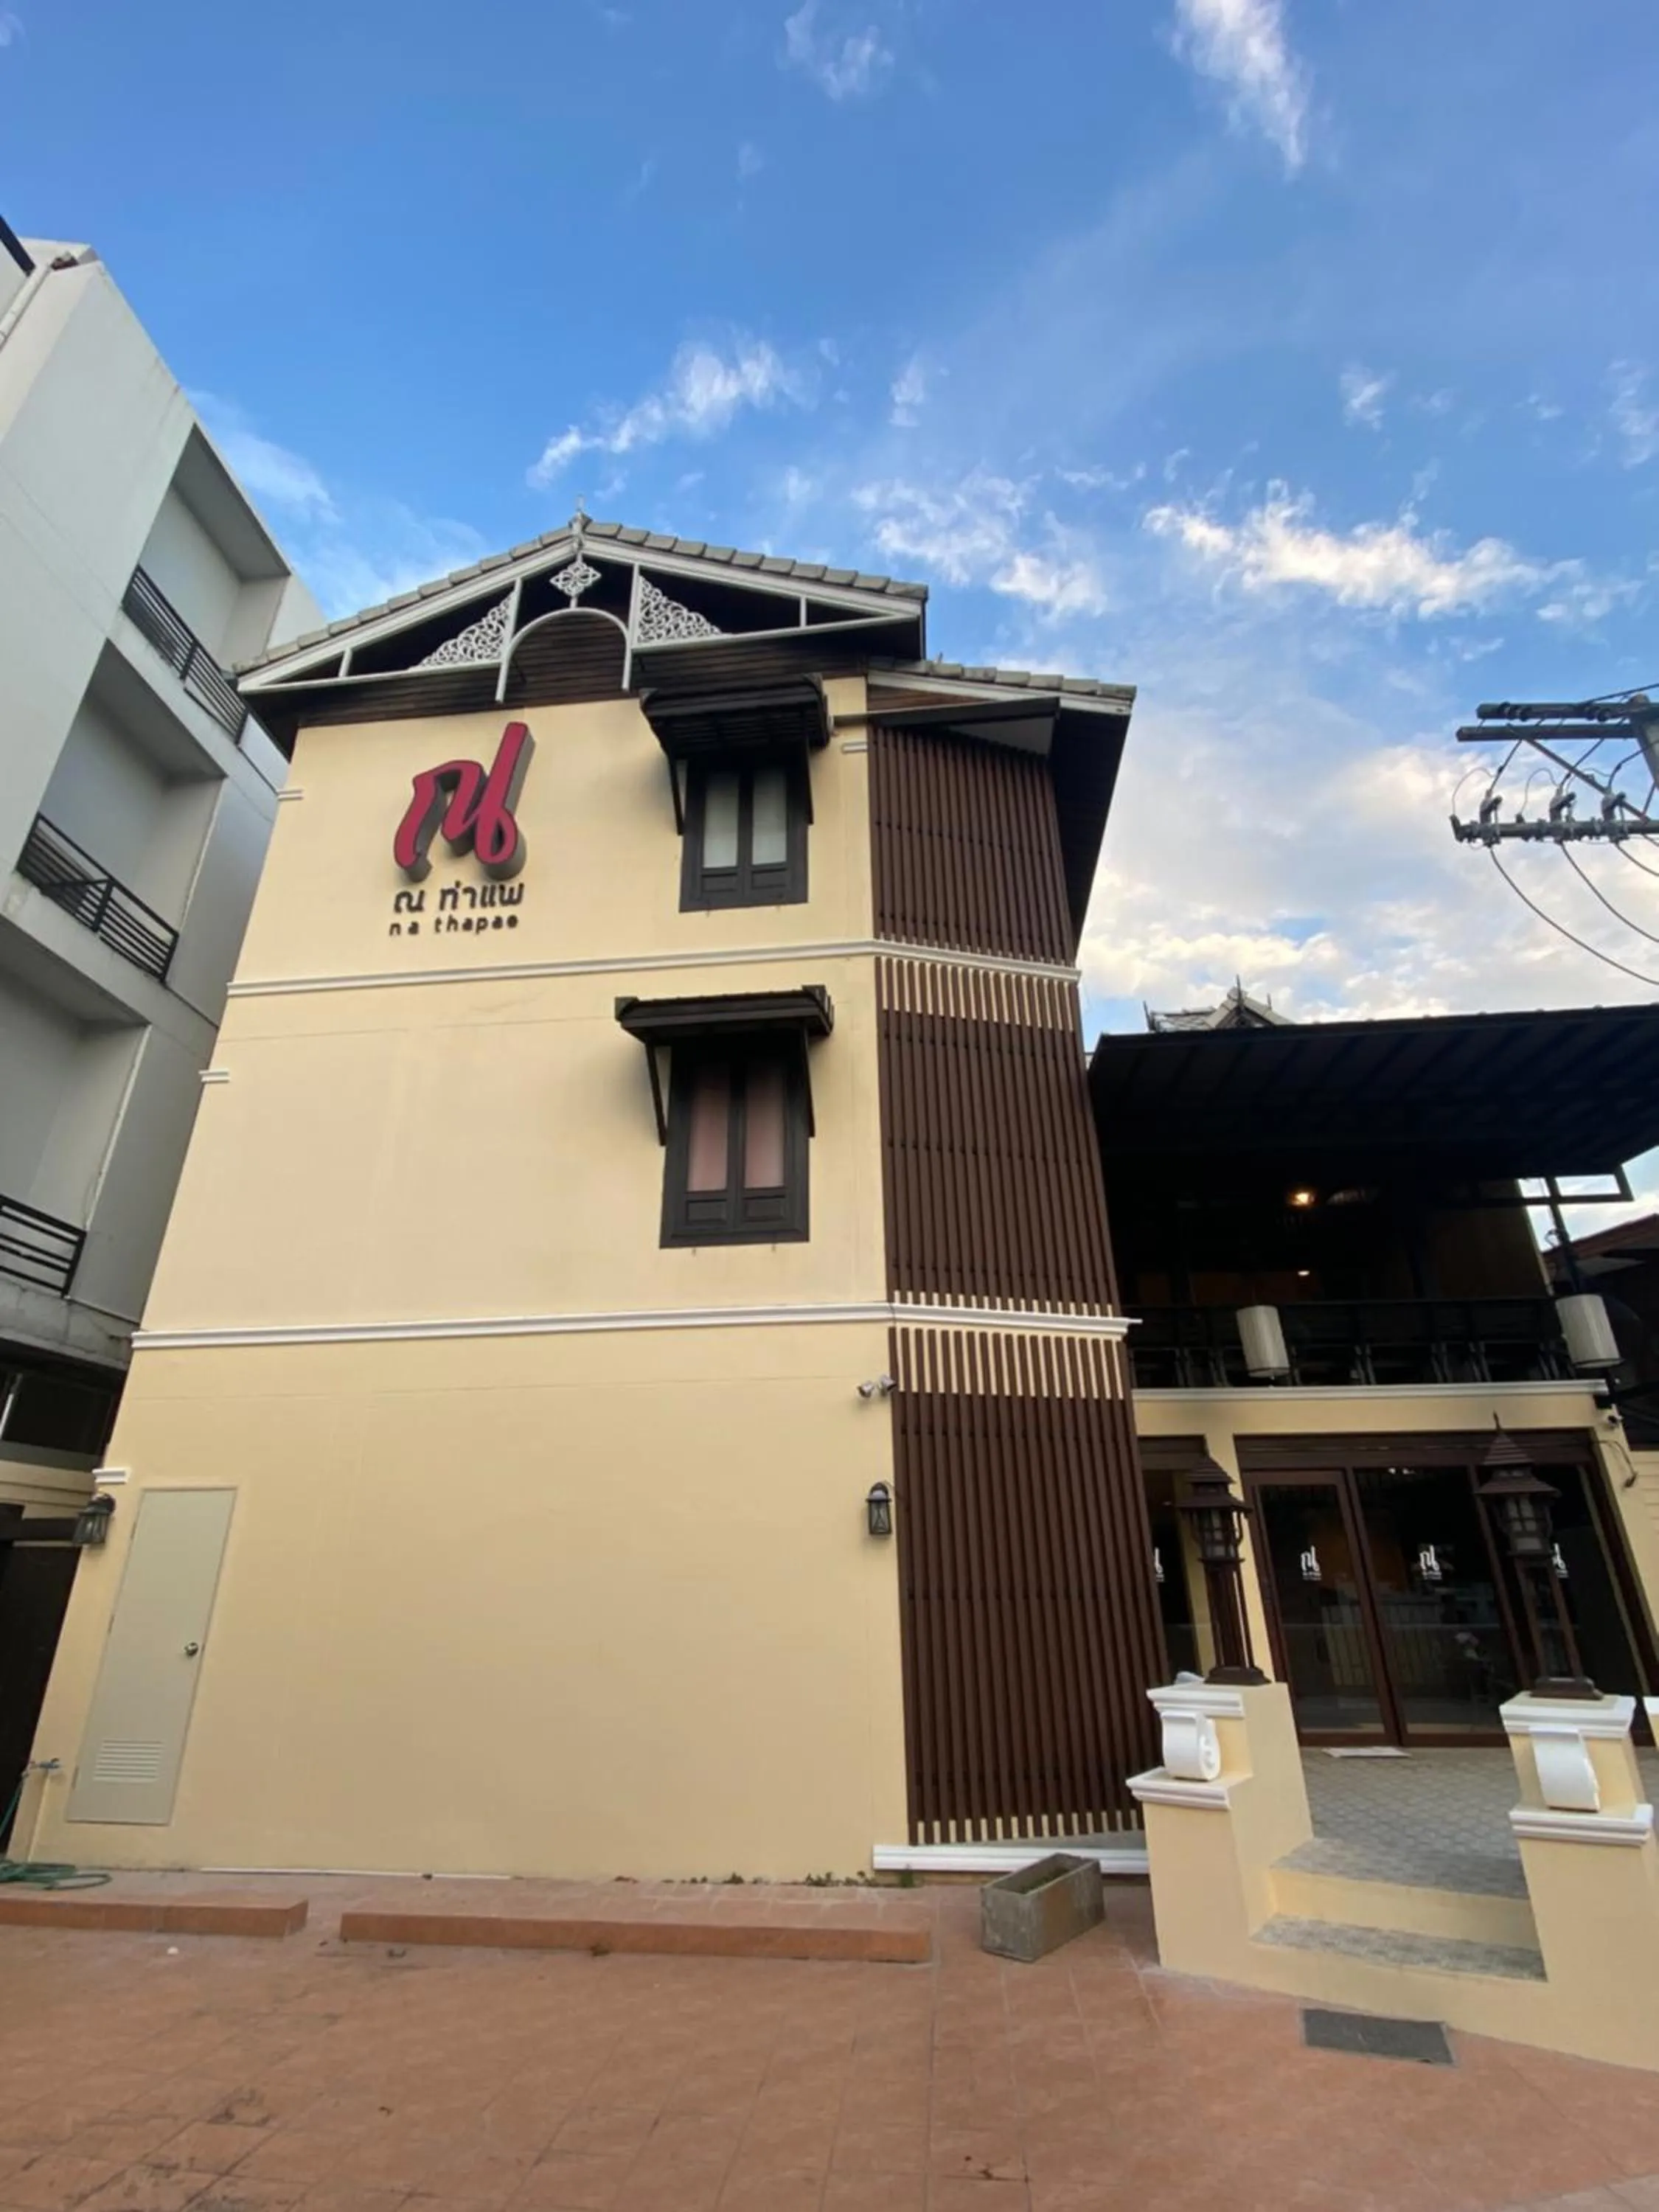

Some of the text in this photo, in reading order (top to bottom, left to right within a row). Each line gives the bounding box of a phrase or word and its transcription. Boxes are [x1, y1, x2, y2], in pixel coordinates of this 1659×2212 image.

[394, 880, 525, 914] ณ ท่าแพ
[389, 914, 518, 936] na thapae
